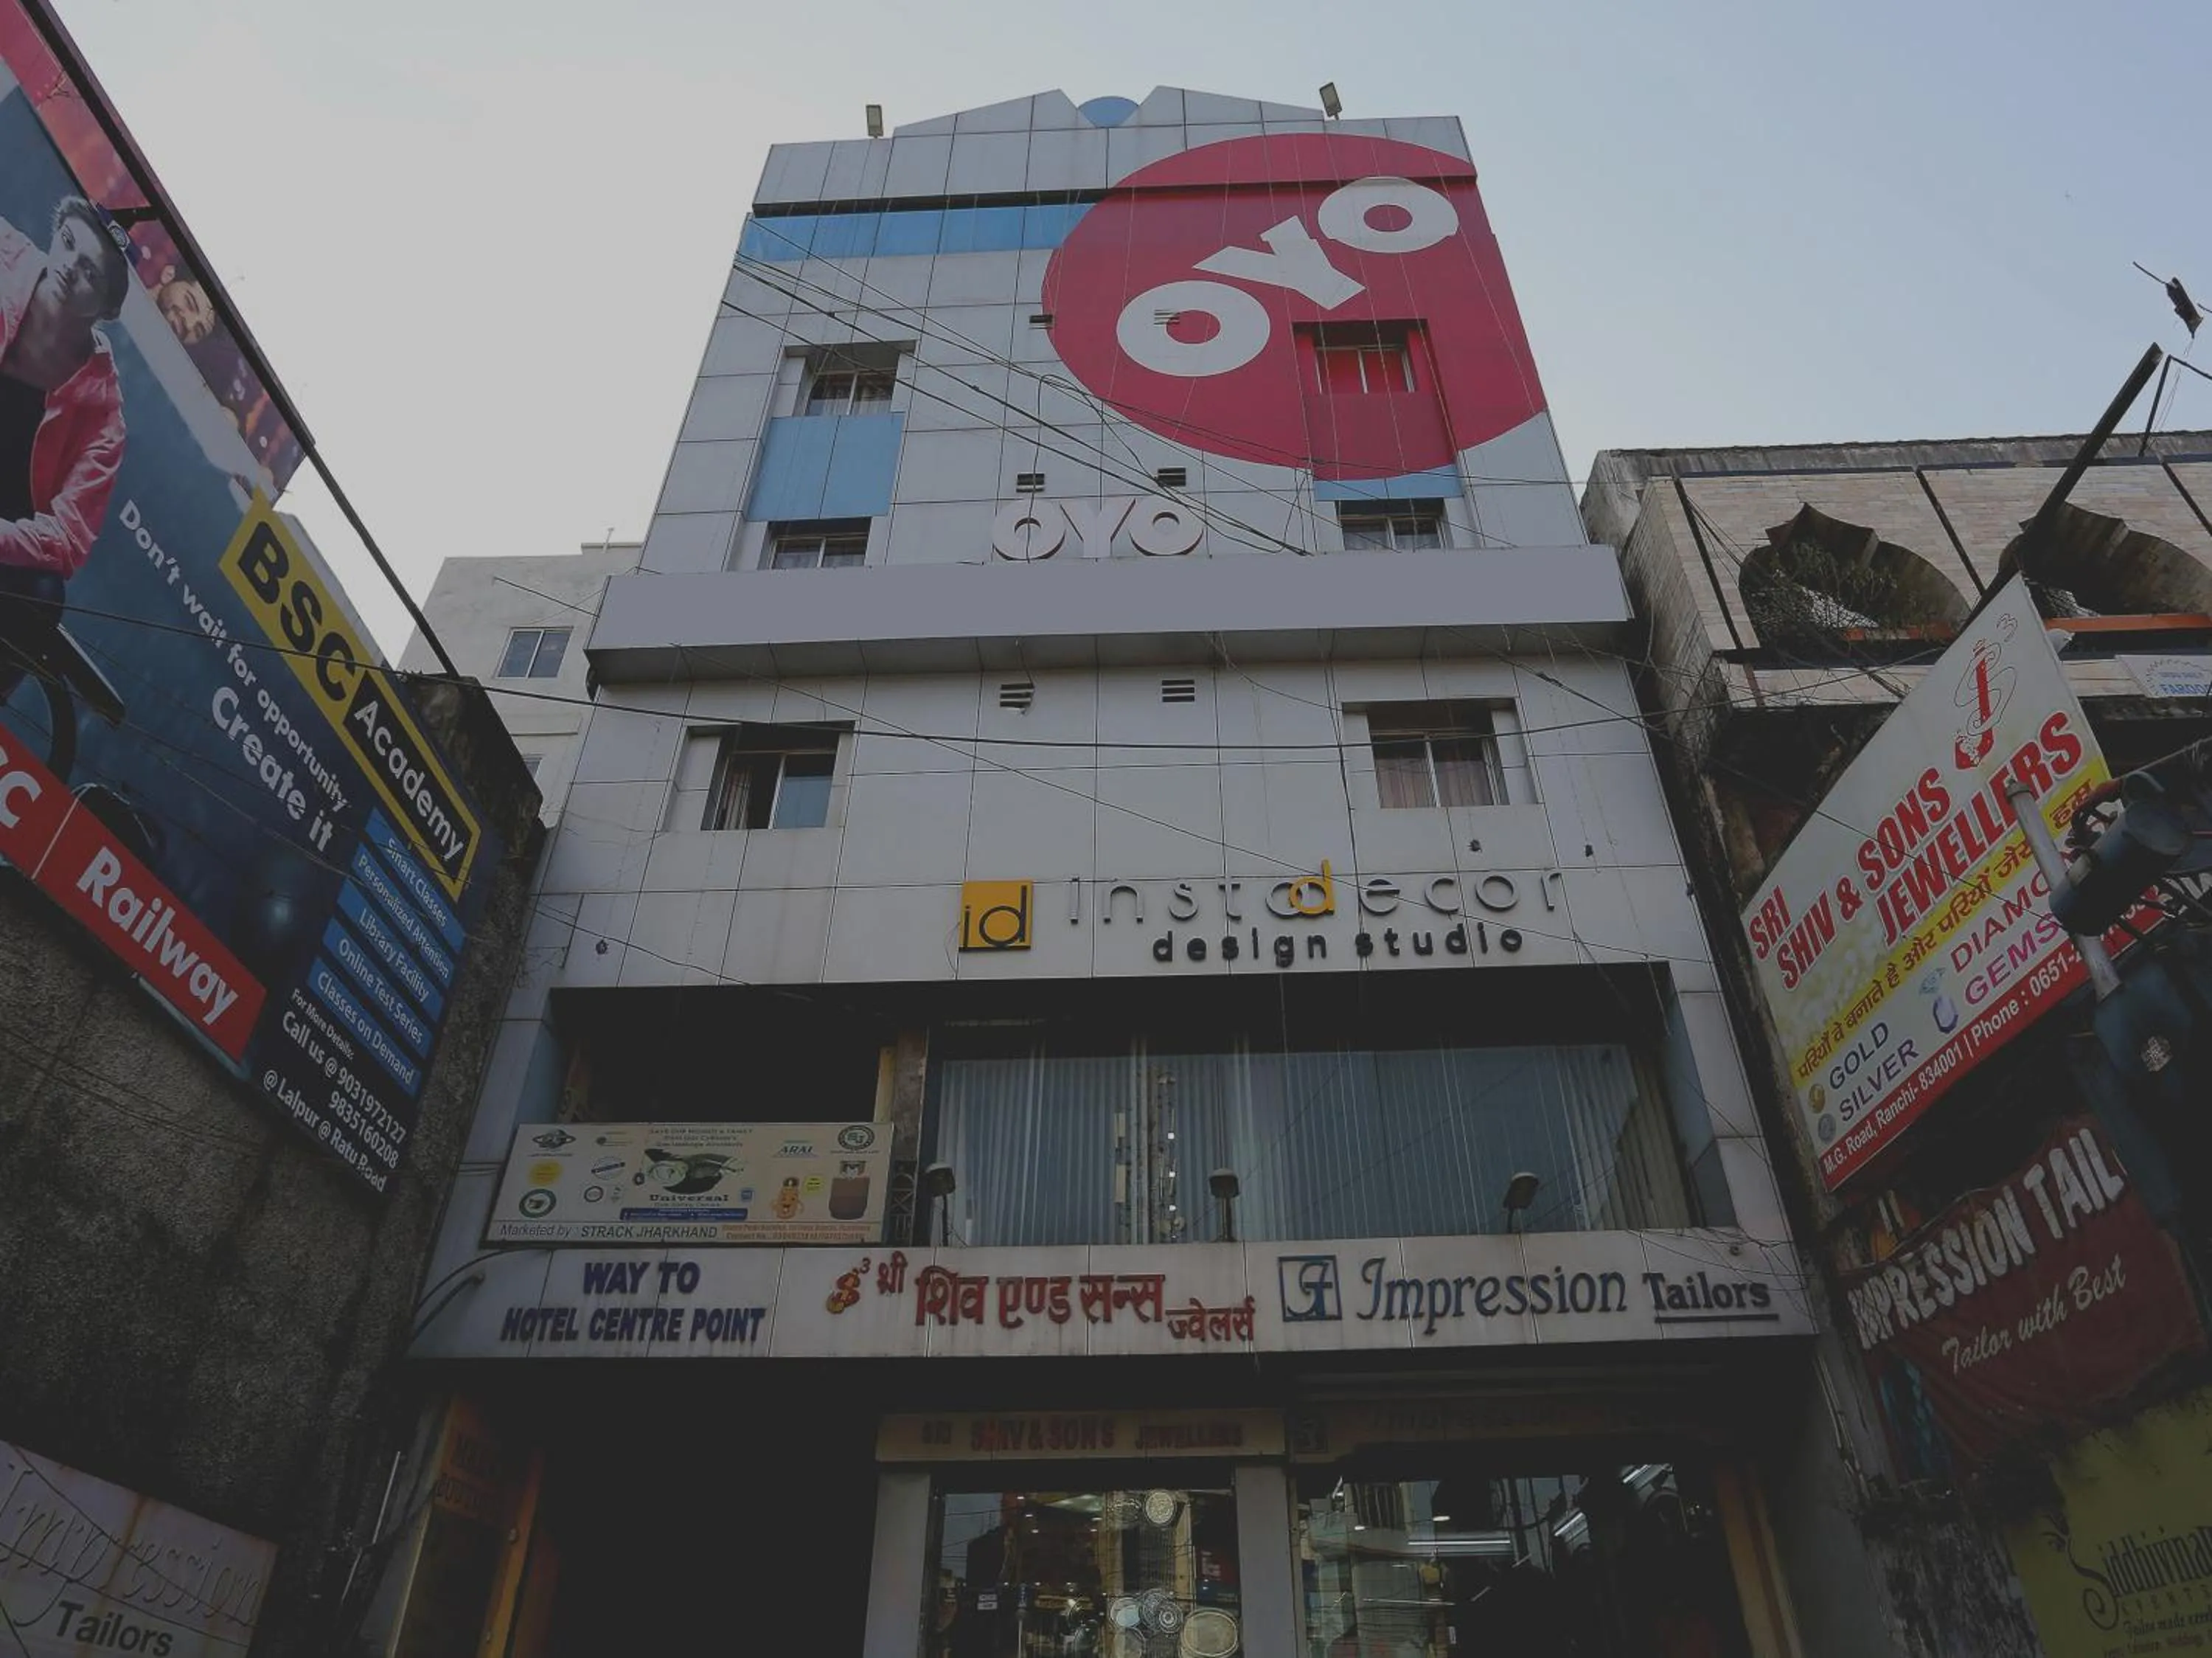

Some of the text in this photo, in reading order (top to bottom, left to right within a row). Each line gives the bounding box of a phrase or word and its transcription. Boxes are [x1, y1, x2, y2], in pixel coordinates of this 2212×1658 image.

[1116, 176, 1458, 377] OYO
[993, 499, 1203, 561] OYO
[119, 499, 349, 811] Don't wait for opportunity
[237, 521, 355, 701] BSC
[0, 745, 43, 828] C
[212, 687, 333, 852] Create it
[354, 701, 464, 861] Academy
[388, 837, 448, 927] Smart Classes
[1747, 887, 1792, 960] SRI
[1775, 768, 1952, 990] SHIV & SONS
[76, 847, 239, 1025] Railway
[359, 908, 429, 1003] Library Facility
[413, 926, 449, 978] Attention
[1152, 923, 1523, 968] design studio
[1964, 913, 2060, 1005] GEMS
[317, 971, 414, 1085] Classes on Demand
[338, 938, 423, 1044] Online Test Series
[283, 1011, 308, 1048] Call
[308, 1039, 326, 1064] us
[1829, 1021, 1890, 1090] GOLD
[1839, 1038, 1919, 1122] SILVER
[1845, 1119, 1877, 1154] Road,
[1918, 1042, 1965, 1091] 834001
[1971, 997, 2020, 1047] Phone
[277, 1078, 319, 1128] Lalpur
[331, 1128, 358, 1164] Ratu
[357, 1153, 387, 1192] Road
[499, 1223, 554, 1238] Marketed
[556, 1224, 571, 1241] by
[580, 1224, 634, 1239] STRACK
[636, 1224, 718, 1239] JHARKHAND
[649, 1193, 729, 1202] Universal
[1847, 1128, 2124, 1350] IMPRESSION TAIL
[583, 1261, 700, 1294] WAY TO
[914, 1265, 989, 1326] शिव
[997, 1276, 1072, 1329] एण्ड
[1079, 1274, 1165, 1325] सन्स
[1165, 1295, 1256, 1342] ज्वेलर्स
[1357, 1257, 1771, 1336] Impression Tailors
[1941, 1253, 2126, 1378] Tailor with Best
[500, 1307, 766, 1342] HOTEL CENTRE POINT
[55, 1600, 174, 1657] Tailors
